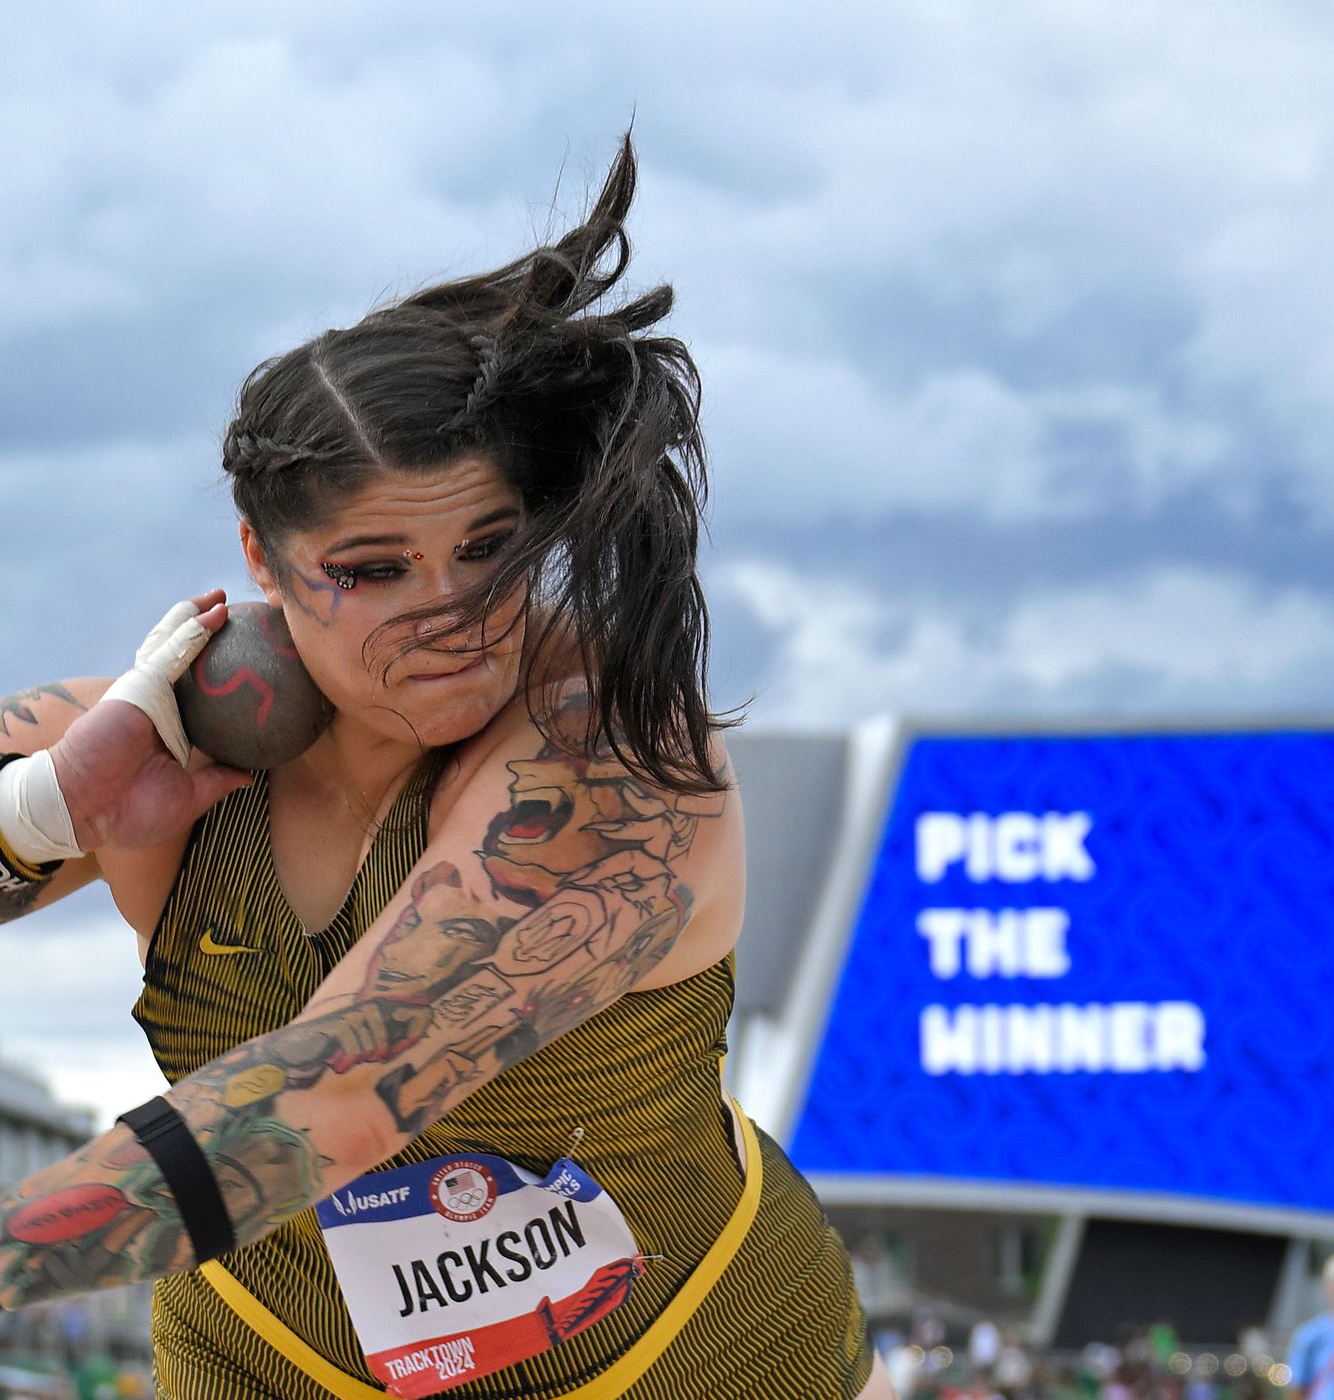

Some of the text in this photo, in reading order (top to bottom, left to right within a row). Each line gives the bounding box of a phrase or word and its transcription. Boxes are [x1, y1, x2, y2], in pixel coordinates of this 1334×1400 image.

[916, 811, 1097, 883] PICK
[917, 907, 1071, 979] THE
[920, 1001, 1207, 1075] WINNER
[357, 1186, 410, 1210] USATF
[391, 1199, 587, 1318] JACKSON
[385, 1336, 475, 1380] TRACKTOWN
[435, 1353, 475, 1381] 2024
